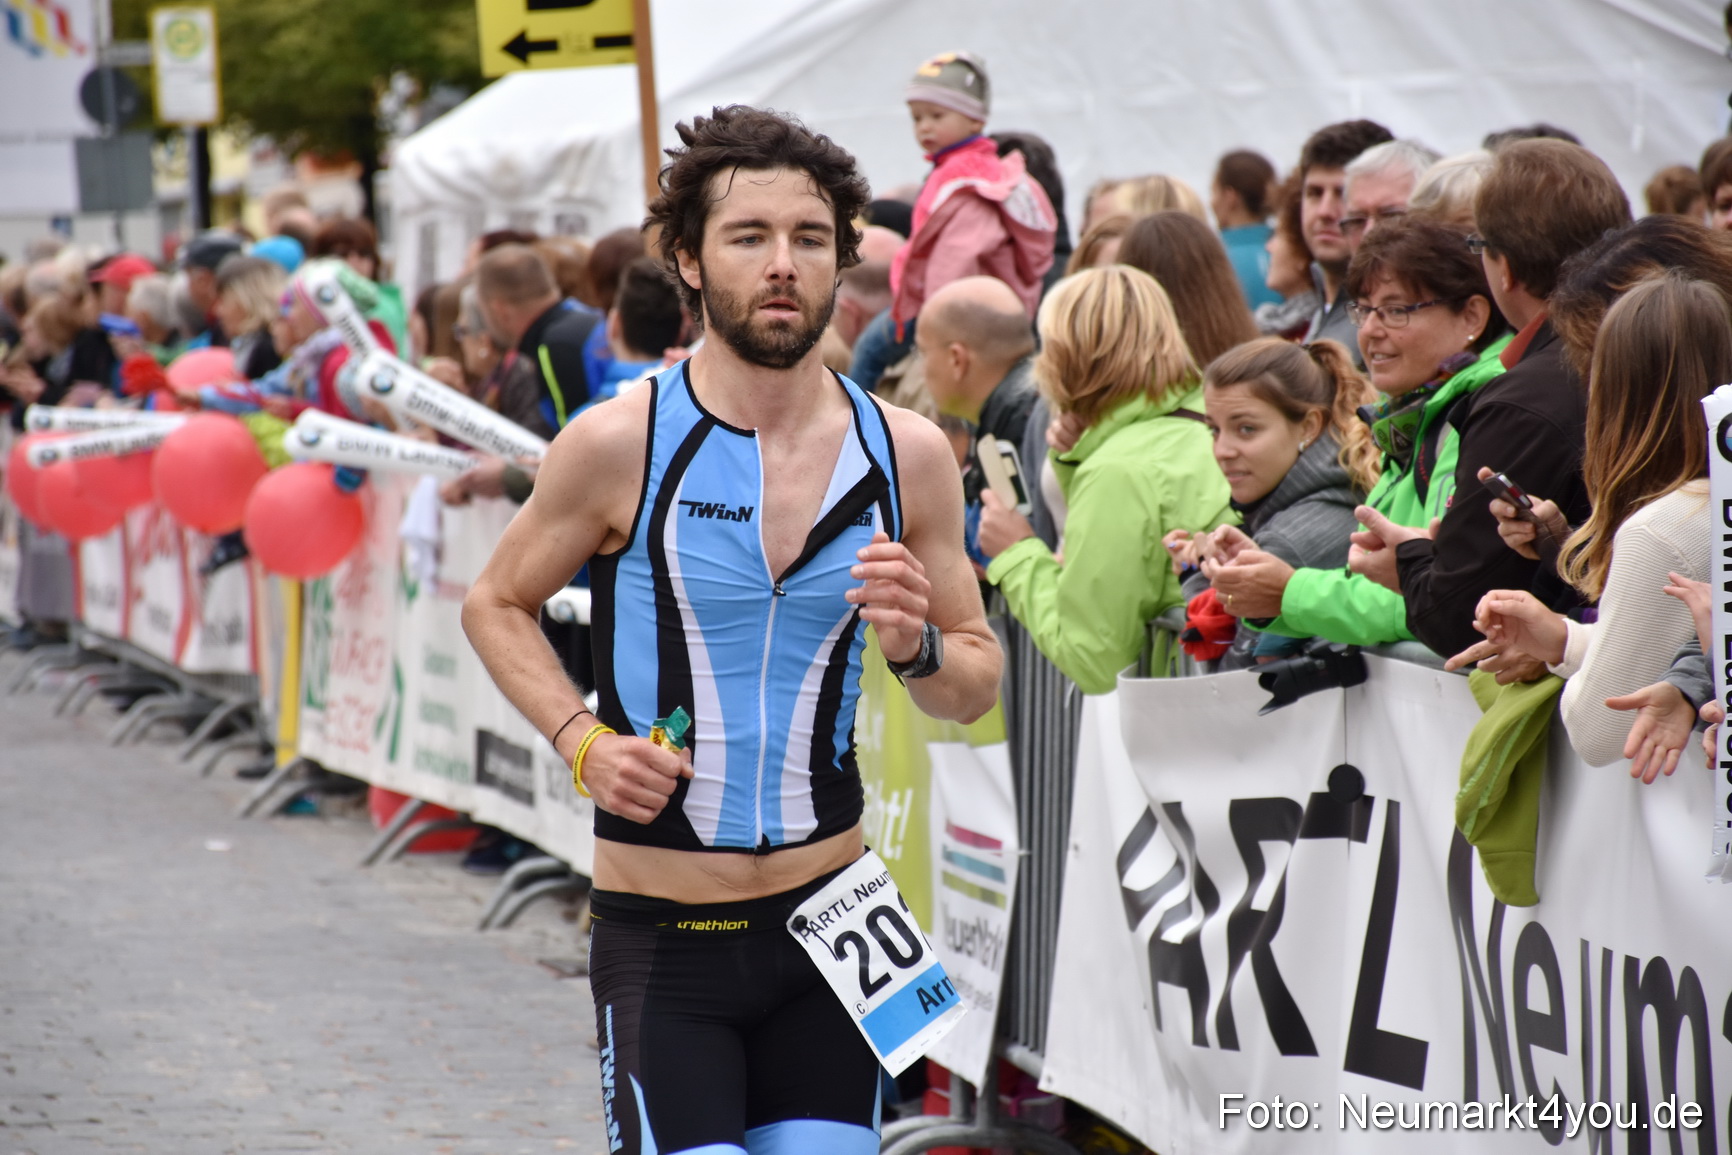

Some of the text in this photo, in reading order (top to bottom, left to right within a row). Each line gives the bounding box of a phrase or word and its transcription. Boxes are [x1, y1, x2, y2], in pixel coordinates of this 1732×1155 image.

[677, 909, 749, 931] triathlon
[833, 891, 933, 1000] 20
[1447, 824, 1732, 1155] Neum
